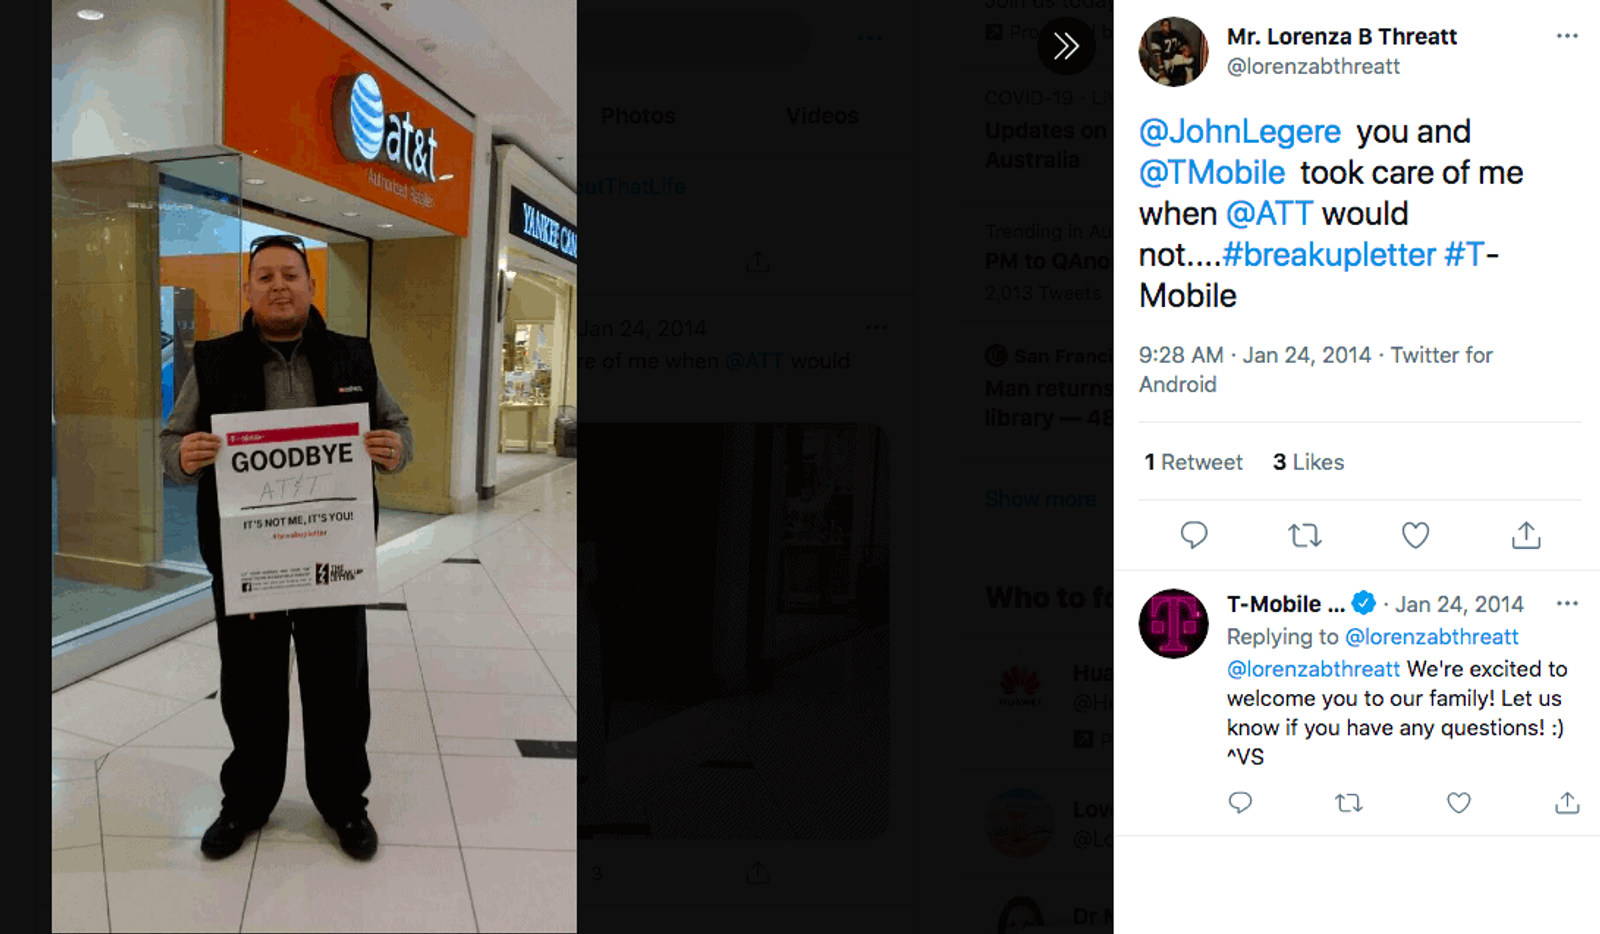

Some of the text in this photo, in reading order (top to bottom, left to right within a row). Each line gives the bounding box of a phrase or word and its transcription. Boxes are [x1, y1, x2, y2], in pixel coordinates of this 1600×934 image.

[1228, 27, 1457, 45] Mr. Lorenza B Threatt
[1228, 57, 1400, 77] @lorenzabthreatt
[986, 90, 1073, 105] COVID-19
[602, 107, 675, 124] Photos
[786, 106, 858, 124] Videos
[986, 122, 1106, 143] Updates on
[1140, 118, 1470, 149] @JohnLegere you and
[386, 112, 437, 183] at&t
[986, 150, 1080, 168] Australia
[1140, 159, 1523, 188] @TMobile took care of me
[1138, 200, 1408, 229] when @ATT would
[523, 202, 560, 249] YANKEE
[986, 223, 1061, 241] Trending
[1069, 223, 1082, 238] in
[986, 253, 1017, 269] PM
[1024, 254, 1046, 269] to
[1444, 241, 1499, 266] #T-
[986, 285, 1101, 301] 2,013 Tweets
[1140, 282, 1237, 307] Mobile
[577, 320, 706, 339] Jan 24, 2014
[603, 352, 622, 369] of
[630, 357, 659, 369] me
[666, 352, 718, 369] when
[726, 352, 784, 372] @ATT
[791, 352, 850, 369] would
[1015, 349, 1049, 363] San
[1140, 345, 1494, 367] 9:28 AM Jan 24, 2014 Twitter for
[986, 380, 1111, 397] Man returns
[1139, 375, 1216, 392] Android
[986, 408, 1054, 430] library
[231, 442, 353, 473] GOODBYE
[1145, 452, 1344, 470] 1 Retweet 3 Likes
[986, 489, 1096, 507] Show more
[243, 511, 354, 530] IT'S NOT ME, IT'S YOU!
[986, 586, 1049, 608] Who
[1056, 587, 1086, 608] to
[1226, 594, 1322, 612] T-Mobile
[1395, 596, 1430, 612] Jan
[1438, 596, 1467, 616] 24,
[1475, 596, 1524, 612] 2014
[1228, 627, 1519, 649] Replying to @lorenzabthreatt
[1228, 659, 1567, 680] @lorenzabthreatt We're excited to
[1227, 688, 1562, 711] welcome you to our family! Let us
[1228, 718, 1280, 736] know
[1286, 718, 1299, 736] if
[1304, 723, 1340, 740] you
[1347, 718, 1394, 736] have
[1399, 723, 1435, 740] any
[1441, 718, 1544, 740] questions!
[1227, 748, 1264, 765] ^VS
[593, 866, 602, 880] 3
[1074, 908, 1098, 925] Dr
